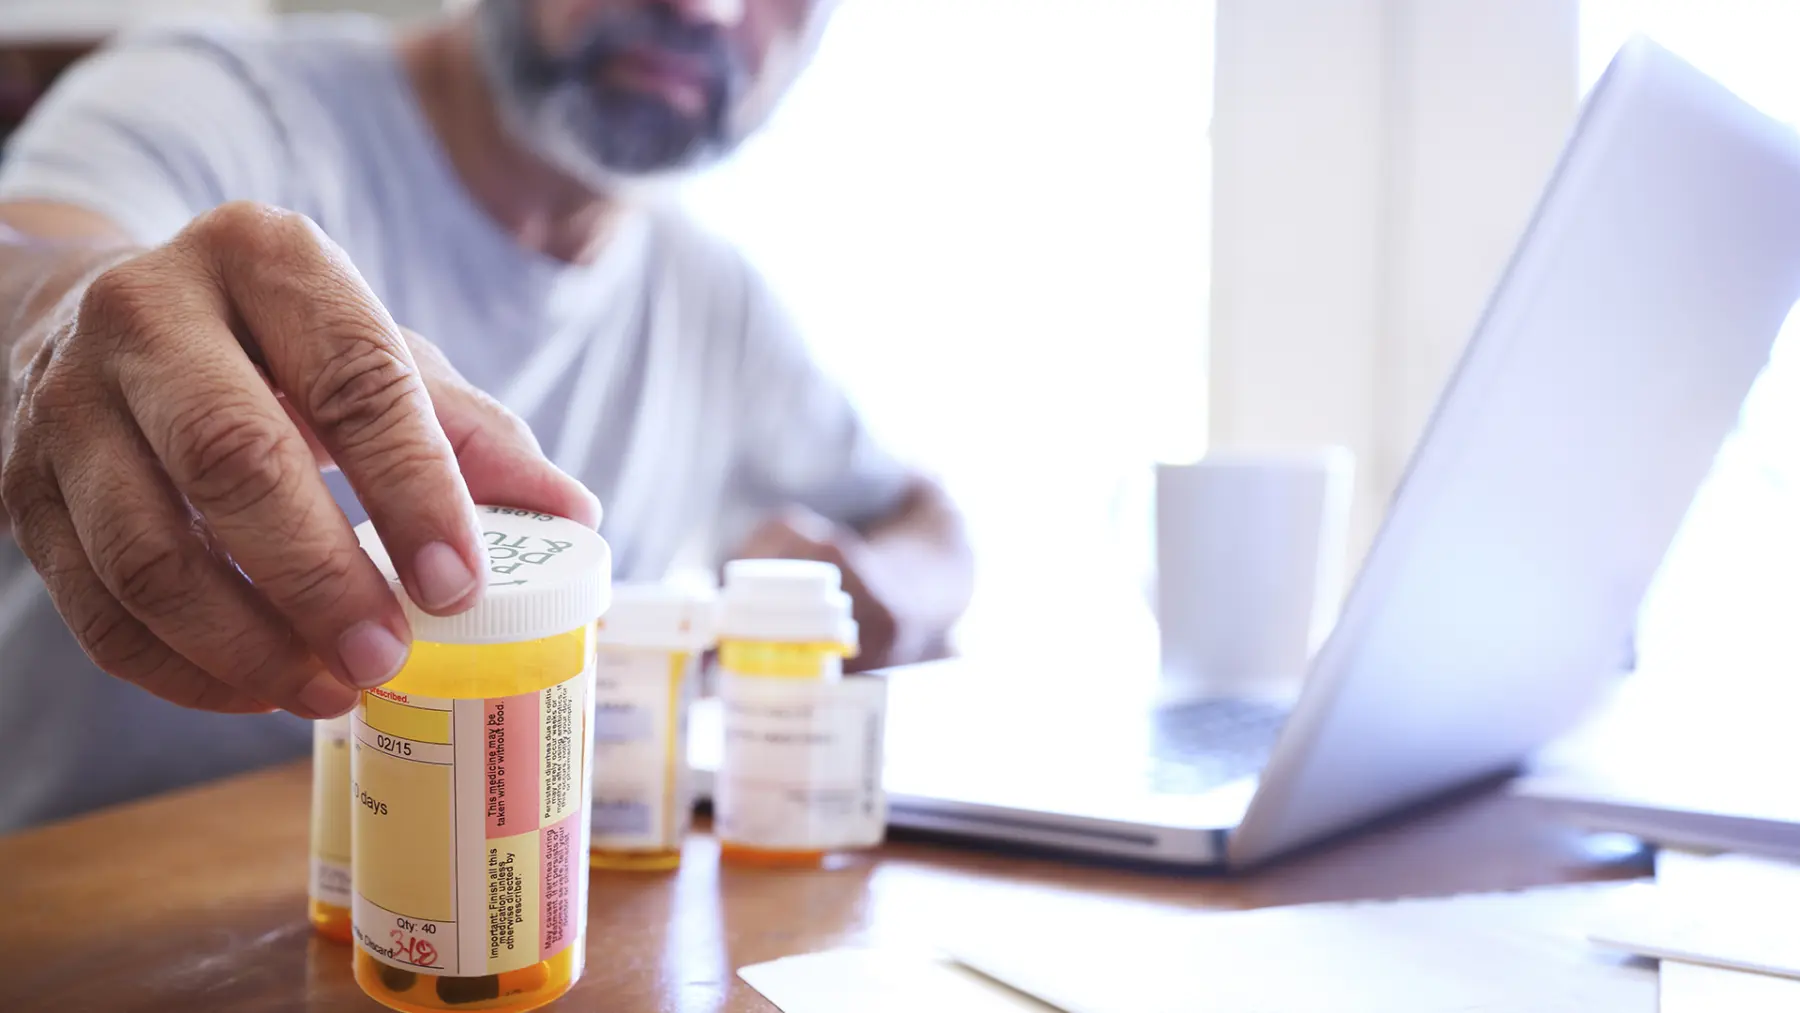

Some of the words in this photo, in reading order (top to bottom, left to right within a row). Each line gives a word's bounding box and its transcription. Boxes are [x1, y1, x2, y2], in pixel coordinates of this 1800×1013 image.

[483, 531, 530, 549] TU
[540, 538, 573, 553] &
[488, 547, 556, 565] DO
[487, 714, 495, 726] be
[496, 701, 504, 726] food.
[378, 735, 411, 756] 02/15
[488, 729, 498, 748] may
[496, 728, 504, 763] without
[487, 751, 496, 794] medicine
[498, 766, 504, 776] or
[496, 779, 505, 798] with
[361, 791, 388, 816] days
[488, 797, 496, 817] This
[497, 801, 505, 826] taken
[488, 848, 497, 866] this
[506, 853, 515, 863] by
[488, 868, 497, 879] all
[498, 861, 506, 891] unless
[489, 881, 498, 909] Finish
[505, 866, 514, 903] directed
[514, 874, 523, 922] prescriber.
[397, 918, 418, 933] Qty:
[422, 924, 436, 934] 40
[498, 895, 506, 944] medication
[506, 906, 514, 949] otherwise
[490, 913, 499, 958] Important:
